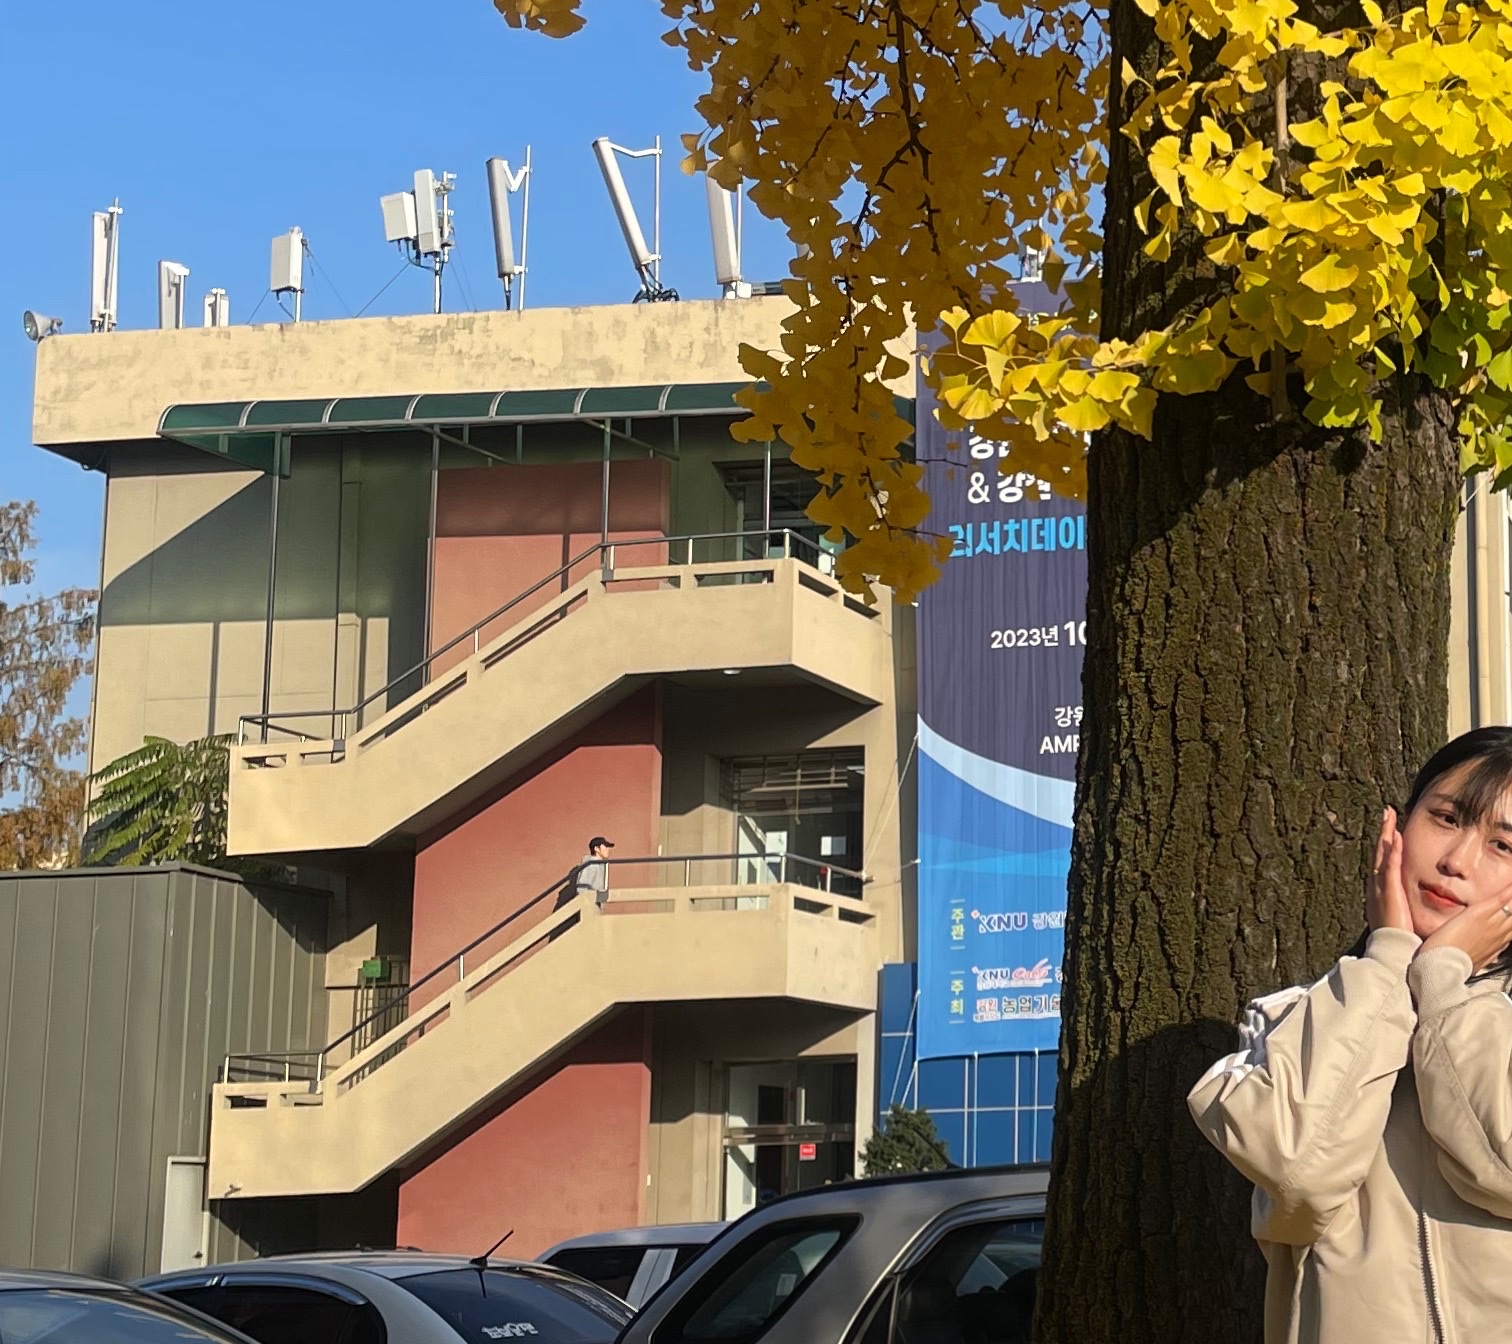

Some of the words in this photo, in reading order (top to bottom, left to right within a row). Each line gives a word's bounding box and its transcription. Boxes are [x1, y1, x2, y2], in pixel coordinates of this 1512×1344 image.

[967, 471, 991, 504] &
[990, 624, 1059, 649] 2023년
[978, 912, 1028, 934] KNU
